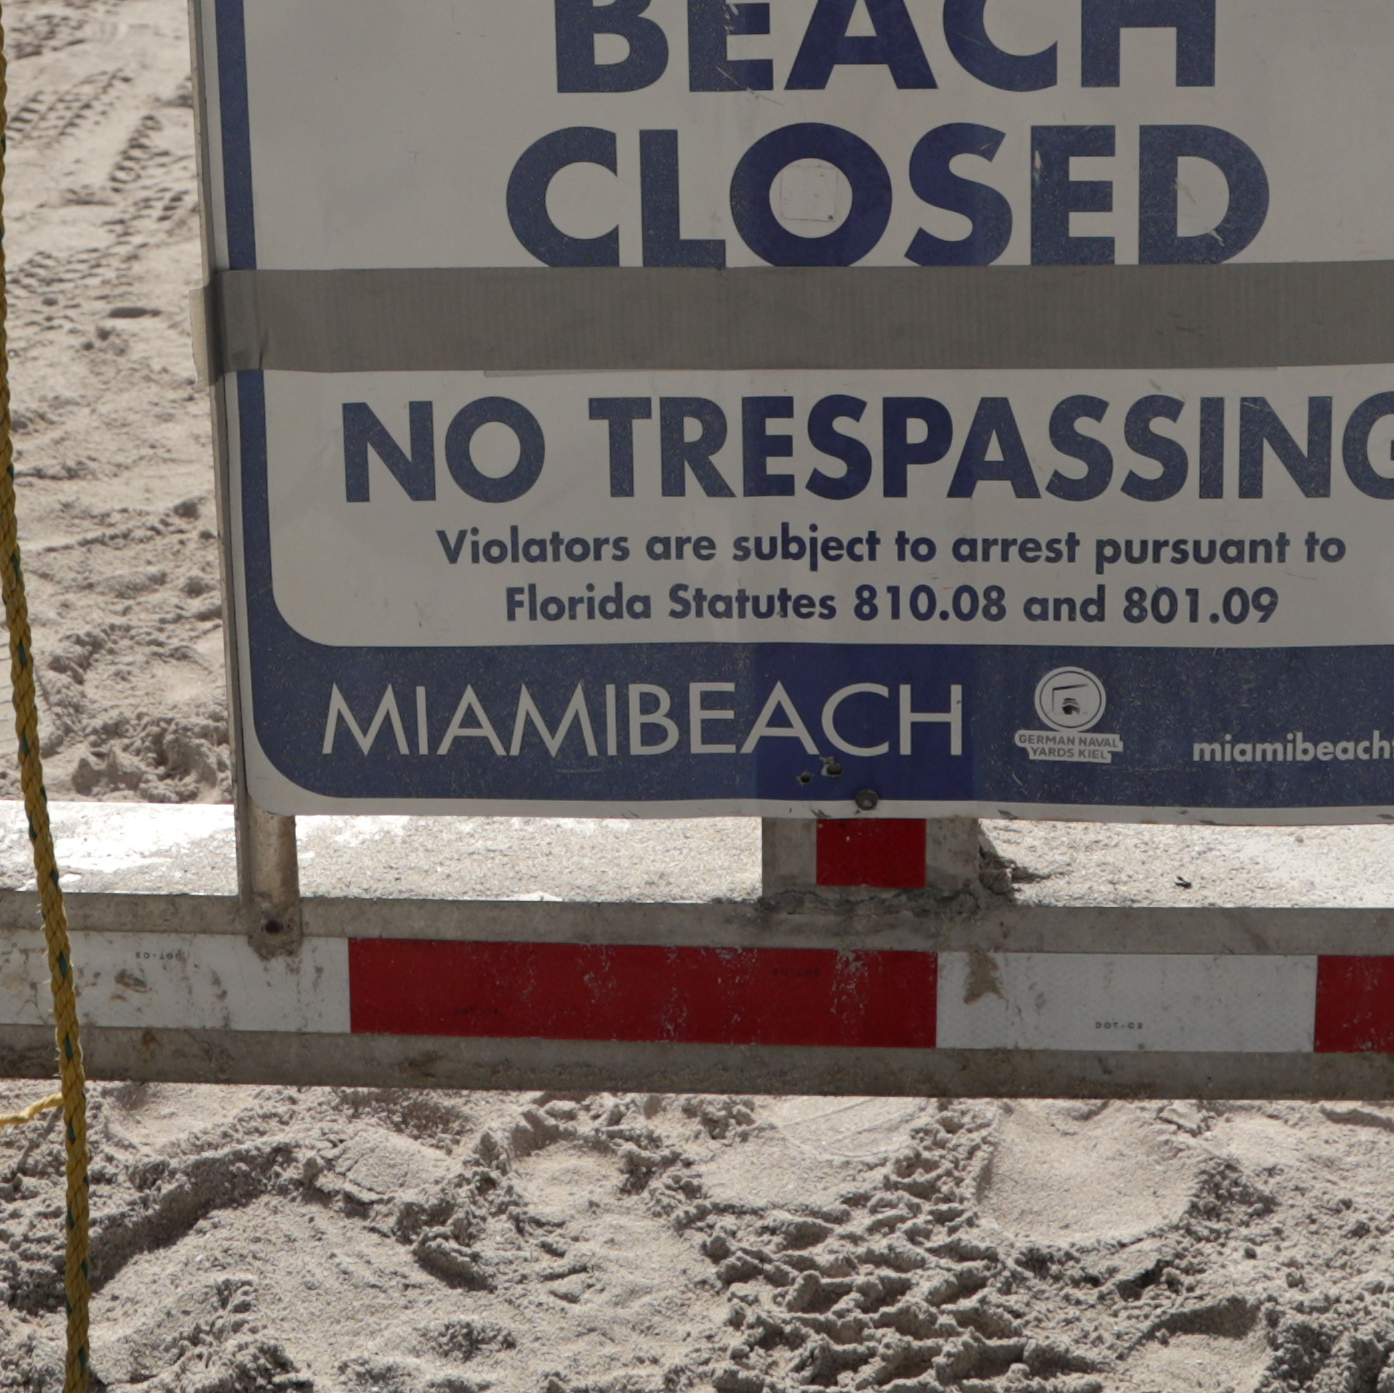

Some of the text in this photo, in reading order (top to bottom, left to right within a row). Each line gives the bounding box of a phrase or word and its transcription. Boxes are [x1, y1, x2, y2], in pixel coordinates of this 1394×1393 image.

[506, 123, 1269, 267] CLOSED
[342, 396, 545, 503] NO
[436, 522, 1346, 574] Violators are subject to arrest pursuant to
[506, 582, 1278, 624] Florida Statutes 810.08 and 801.09
[322, 681, 962, 757] MIAMIBEACH
[1018, 734, 1118, 748] GERMAN NAVAL
[1031, 747, 1107, 759] YARDS KIEL
[1095, 1021, 1143, 1029] DOT-C2
